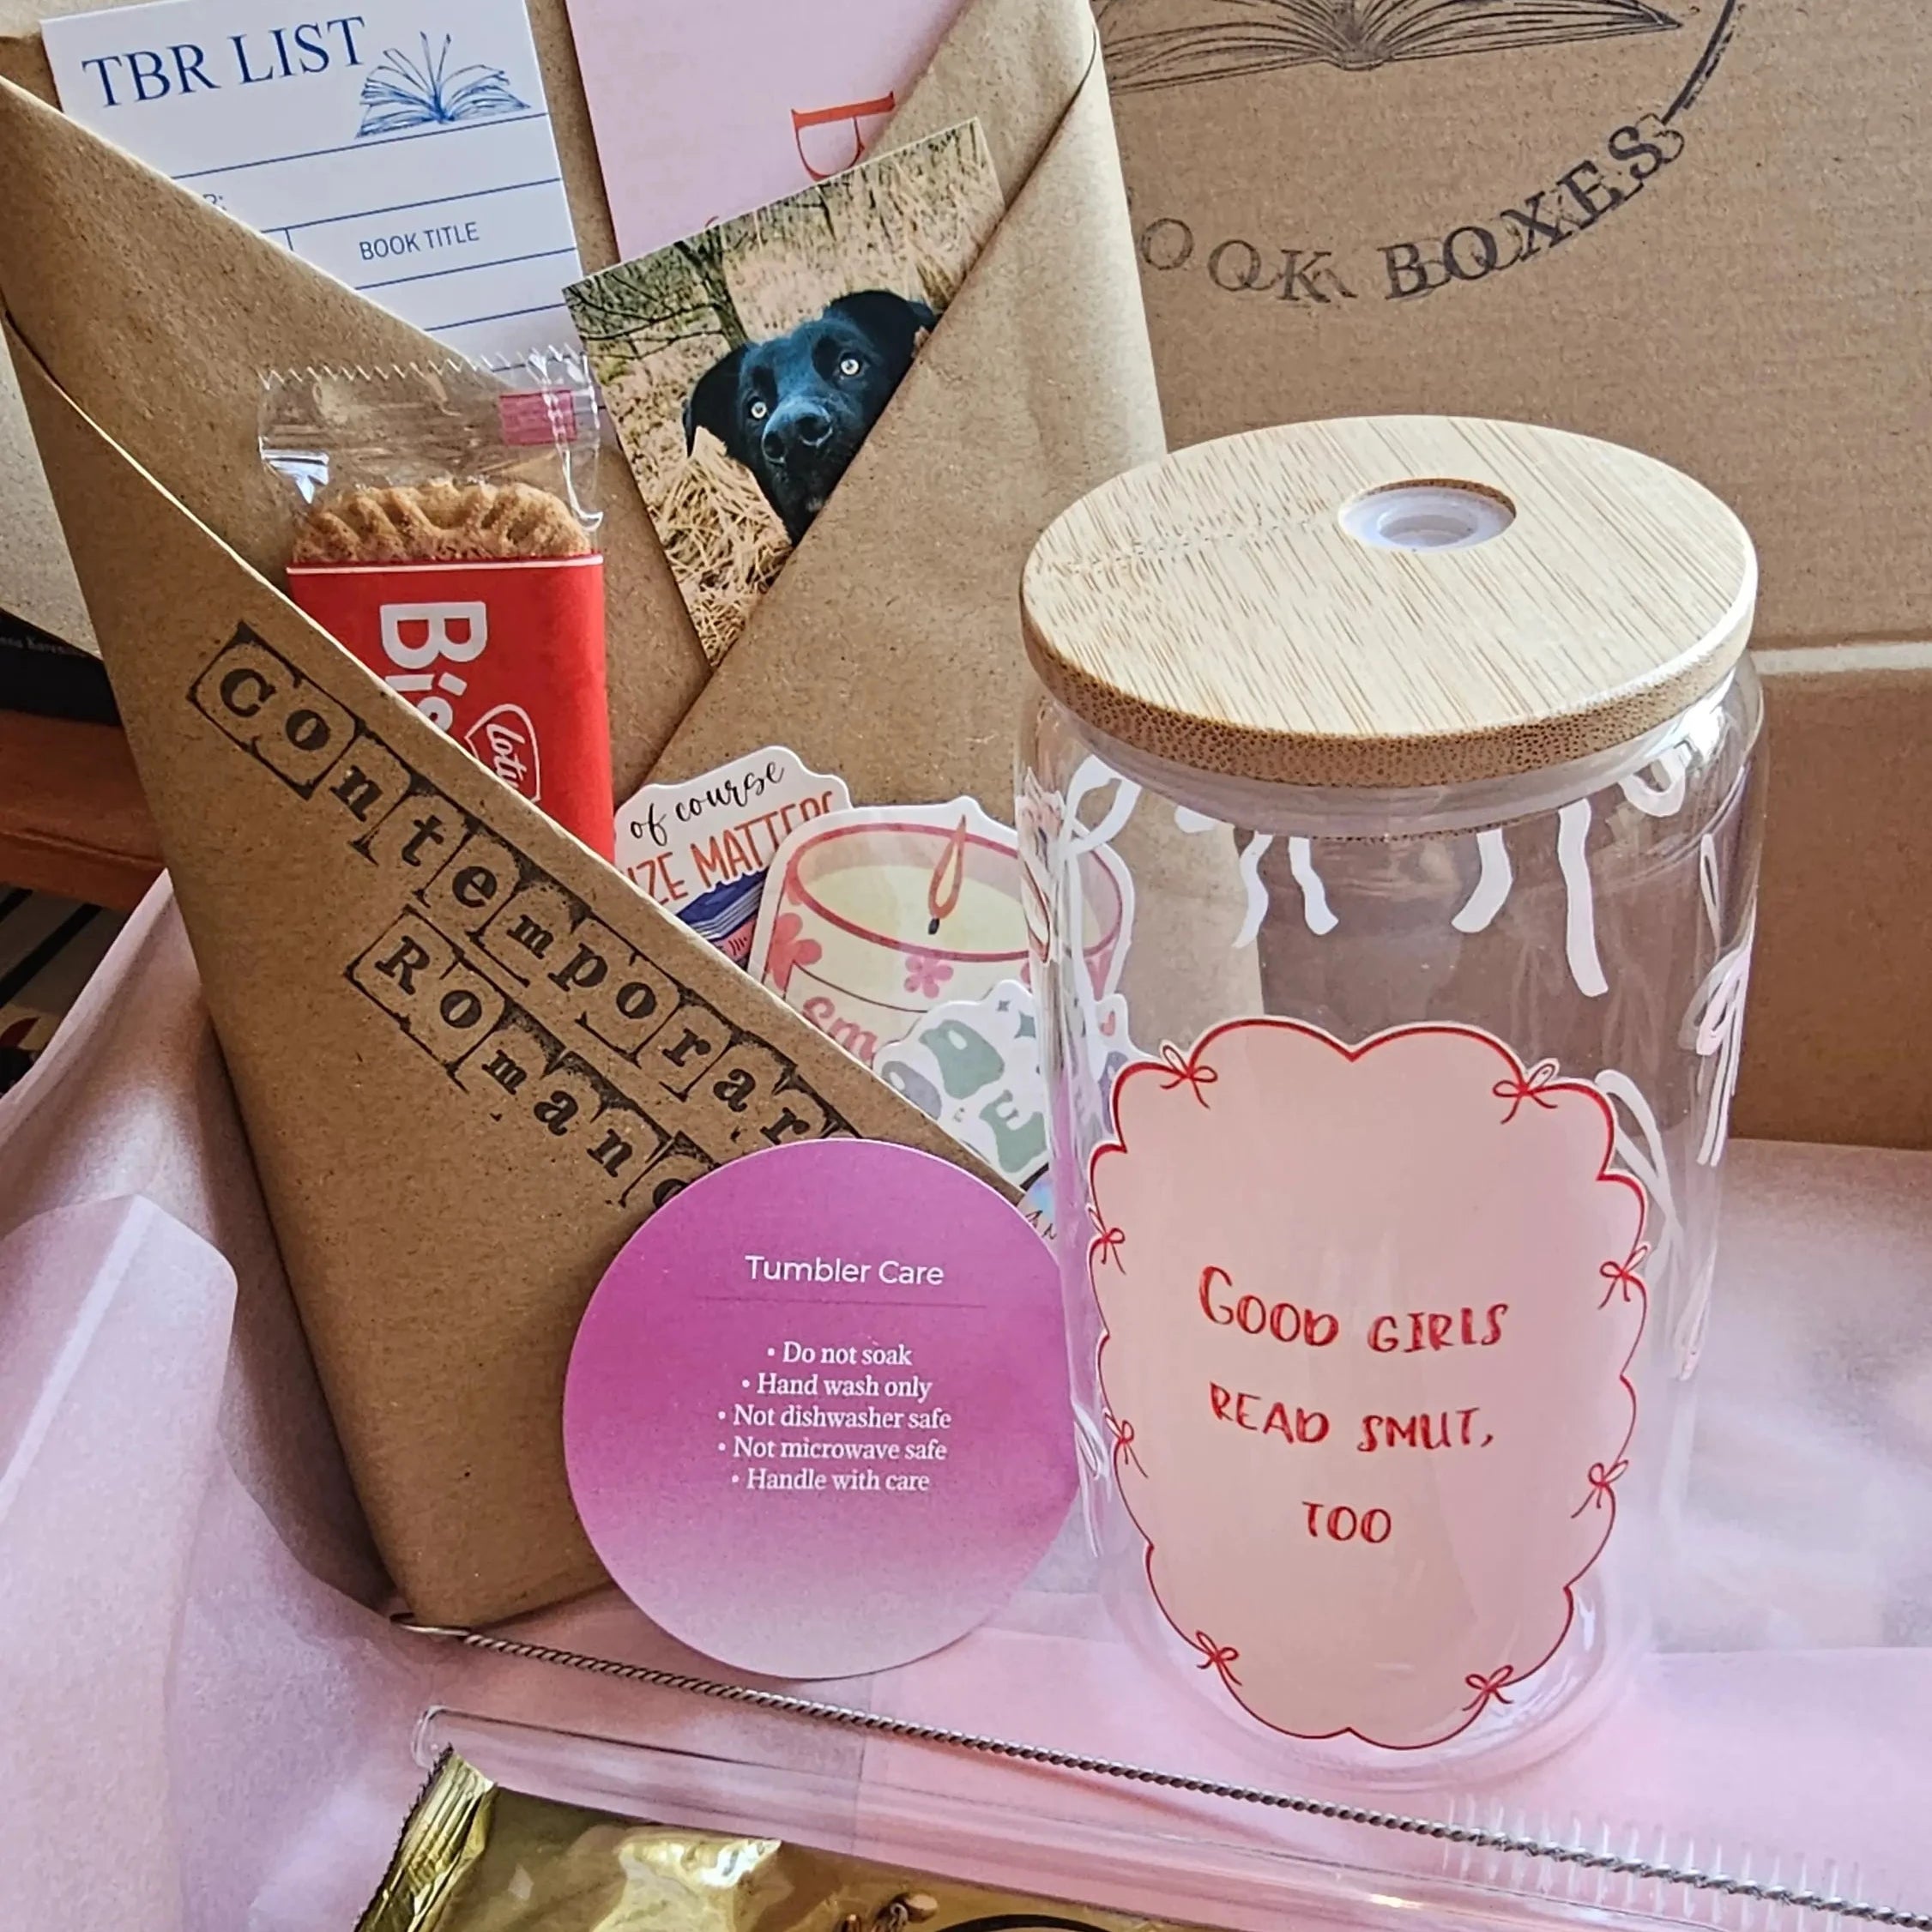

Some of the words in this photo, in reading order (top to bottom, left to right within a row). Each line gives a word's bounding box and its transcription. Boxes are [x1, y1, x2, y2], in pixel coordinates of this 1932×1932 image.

[82, 43, 221, 108] TBR
[227, 16, 366, 85] LIST
[1139, 217, 1358, 305] OOK
[1377, 115, 1683, 301] BOXES
[359, 233, 420, 261] BOOK
[424, 221, 480, 251] TITLE
[630, 803, 667, 847] of
[675, 761, 784, 823] course
[745, 1254, 872, 1283] Tumbler
[878, 1259, 945, 1286] Care
[1198, 1265, 1339, 1347] GOOD
[1367, 1303, 1510, 1354] GIRLS
[782, 1341, 816, 1364] Do
[820, 1344, 857, 1365] not
[860, 1343, 913, 1366] soak
[756, 1372, 818, 1396] Hand
[824, 1374, 879, 1397] wash
[884, 1375, 933, 1404] only
[733, 1404, 774, 1428] Not
[780, 1404, 904, 1428] dishwasher
[907, 1407, 952, 1429] safe
[1210, 1380, 1331, 1445] READ
[1356, 1407, 1494, 1452] SMUT,
[733, 1435, 776, 1458] Not
[780, 1437, 900, 1459] microwave
[904, 1438, 948, 1460] safe
[746, 1468, 827, 1491] Handle
[831, 1469, 881, 1492] with
[885, 1472, 931, 1492] care
[1301, 1500, 1392, 1545] TOO
